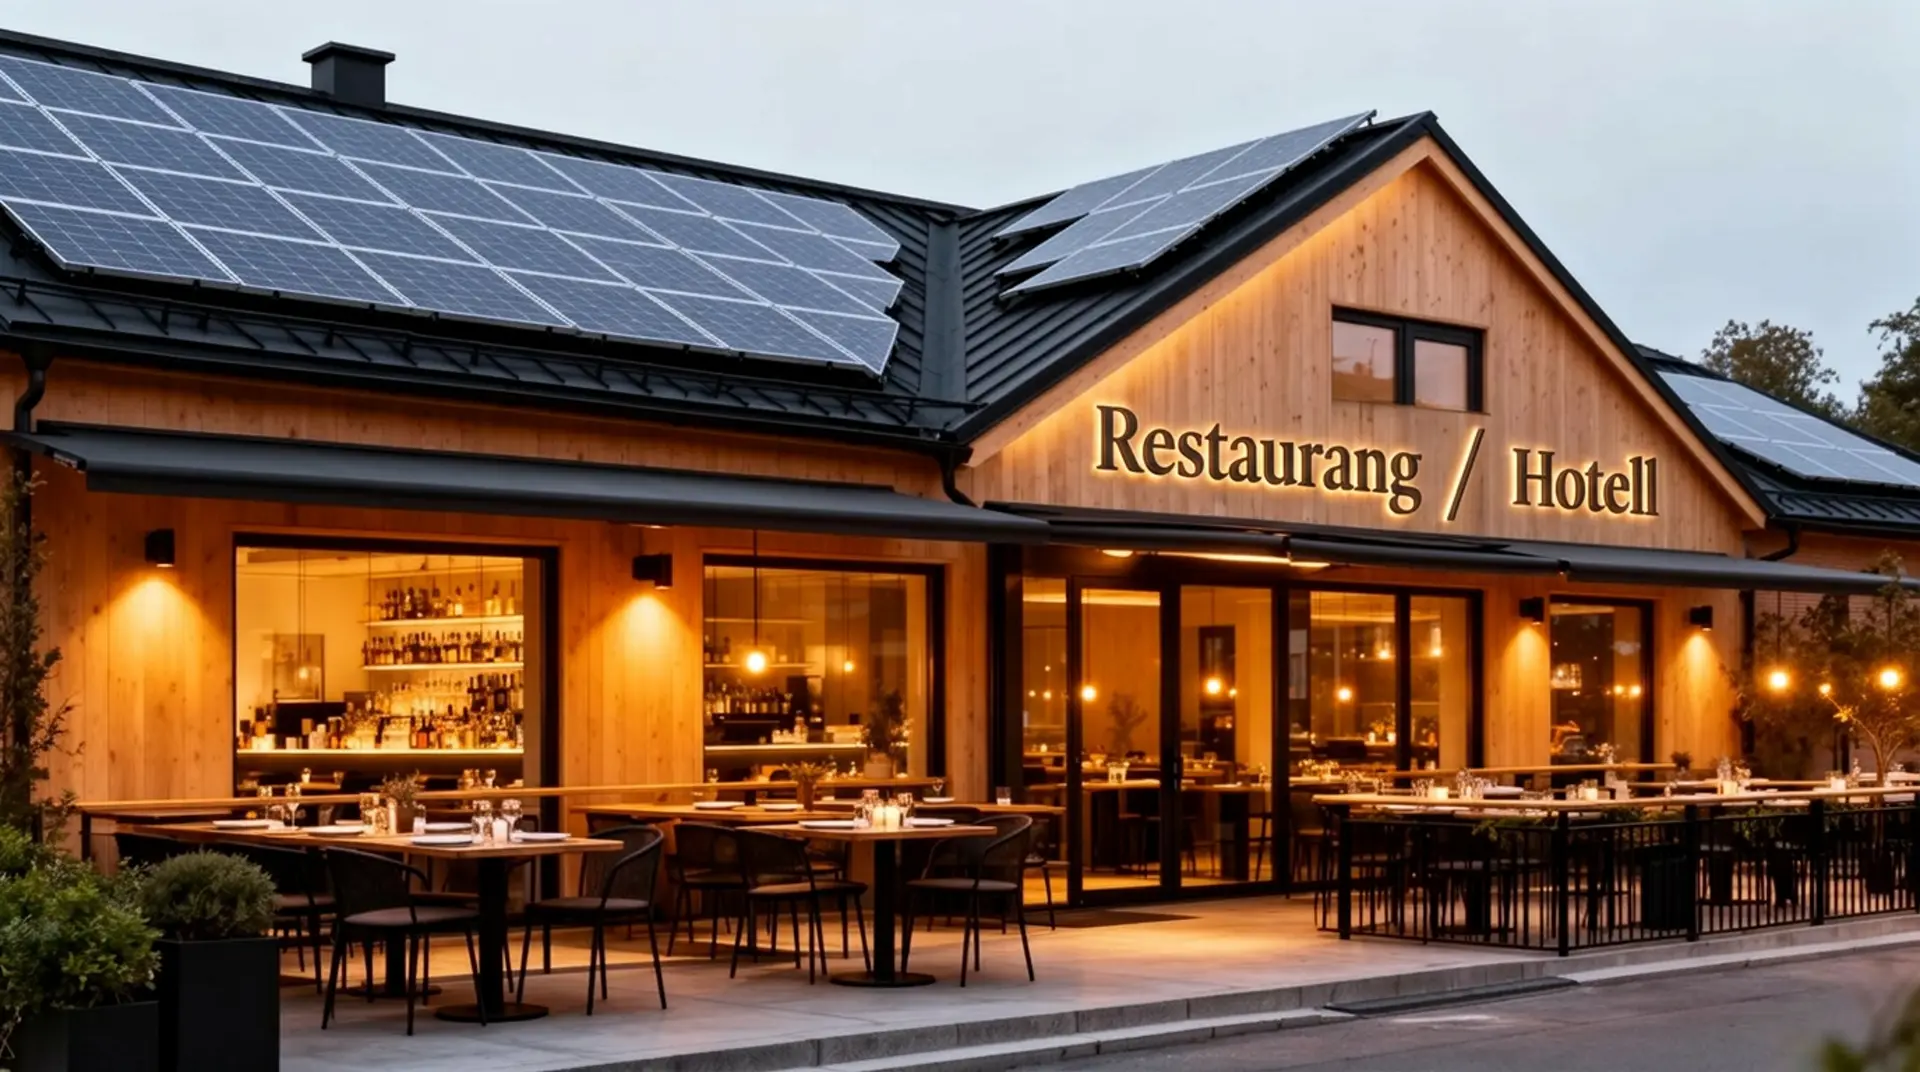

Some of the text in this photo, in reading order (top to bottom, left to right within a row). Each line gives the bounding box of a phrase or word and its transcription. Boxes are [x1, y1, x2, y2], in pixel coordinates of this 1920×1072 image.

[1096, 405, 1658, 521] Restaurang / Hotell
